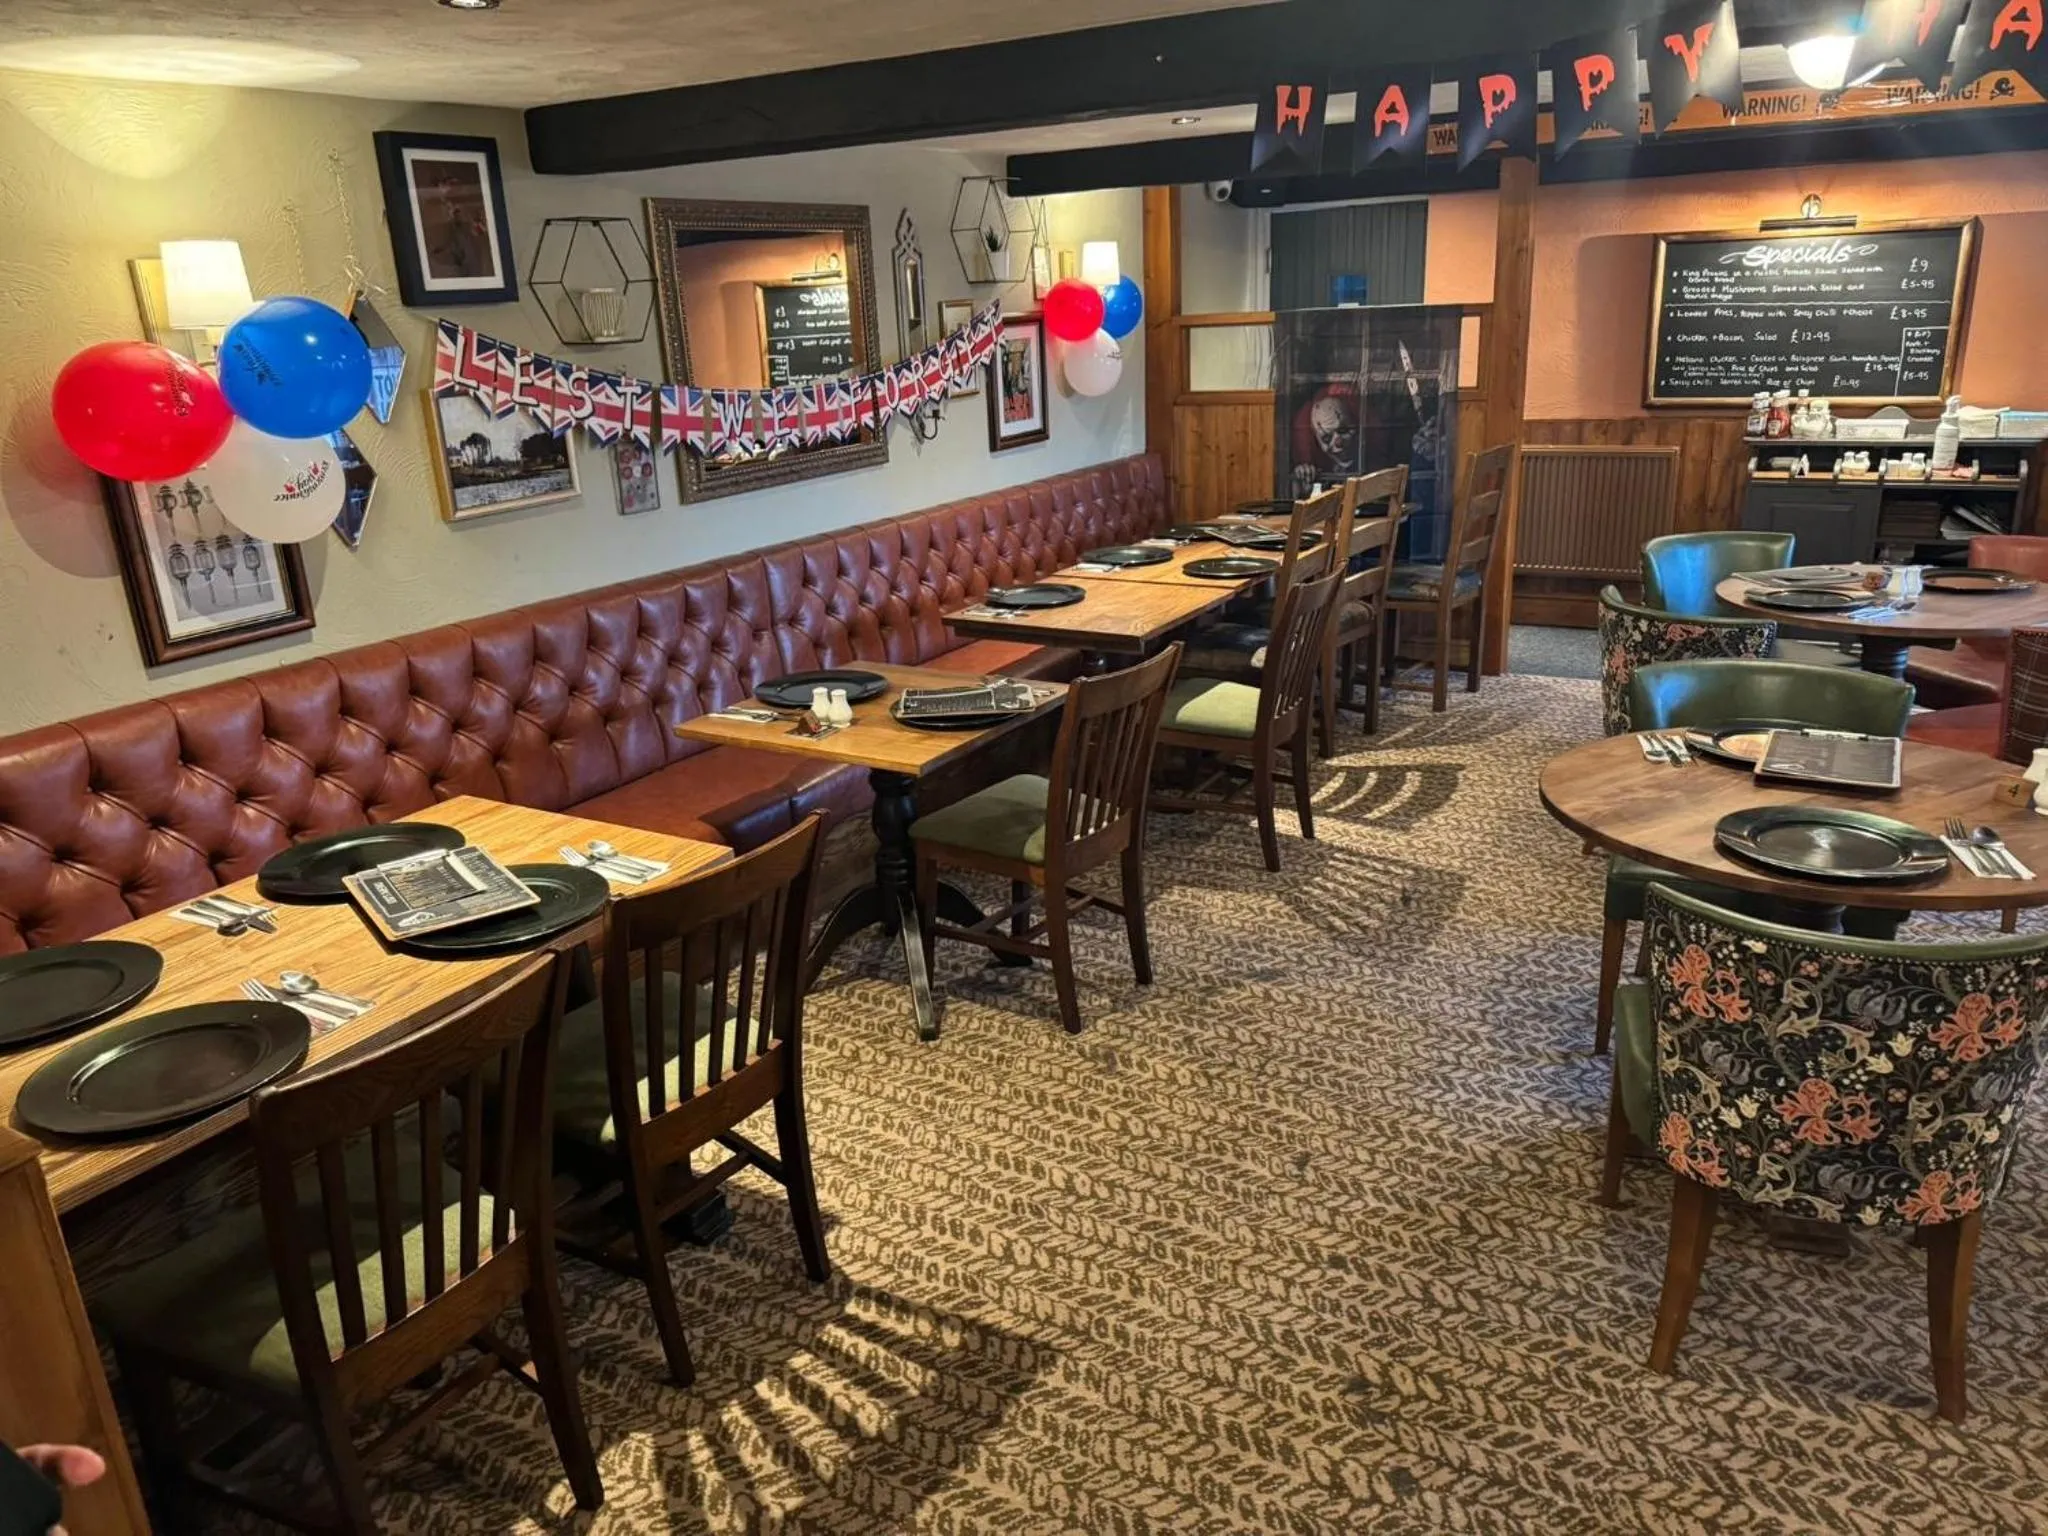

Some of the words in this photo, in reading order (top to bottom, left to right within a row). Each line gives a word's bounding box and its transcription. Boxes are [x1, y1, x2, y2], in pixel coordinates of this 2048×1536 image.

[1275, 22, 1713, 137] HAPPY
[1740, 238, 1852, 270] Specials
[1908, 256, 1929, 273] £9
[1682, 285, 1716, 294] Breaded
[1677, 309, 1708, 318] Loaded
[1753, 330, 1778, 342] Salad
[452, 332, 643, 432] LEST
[716, 389, 792, 438] WE
[848, 305, 998, 427] FORGET
